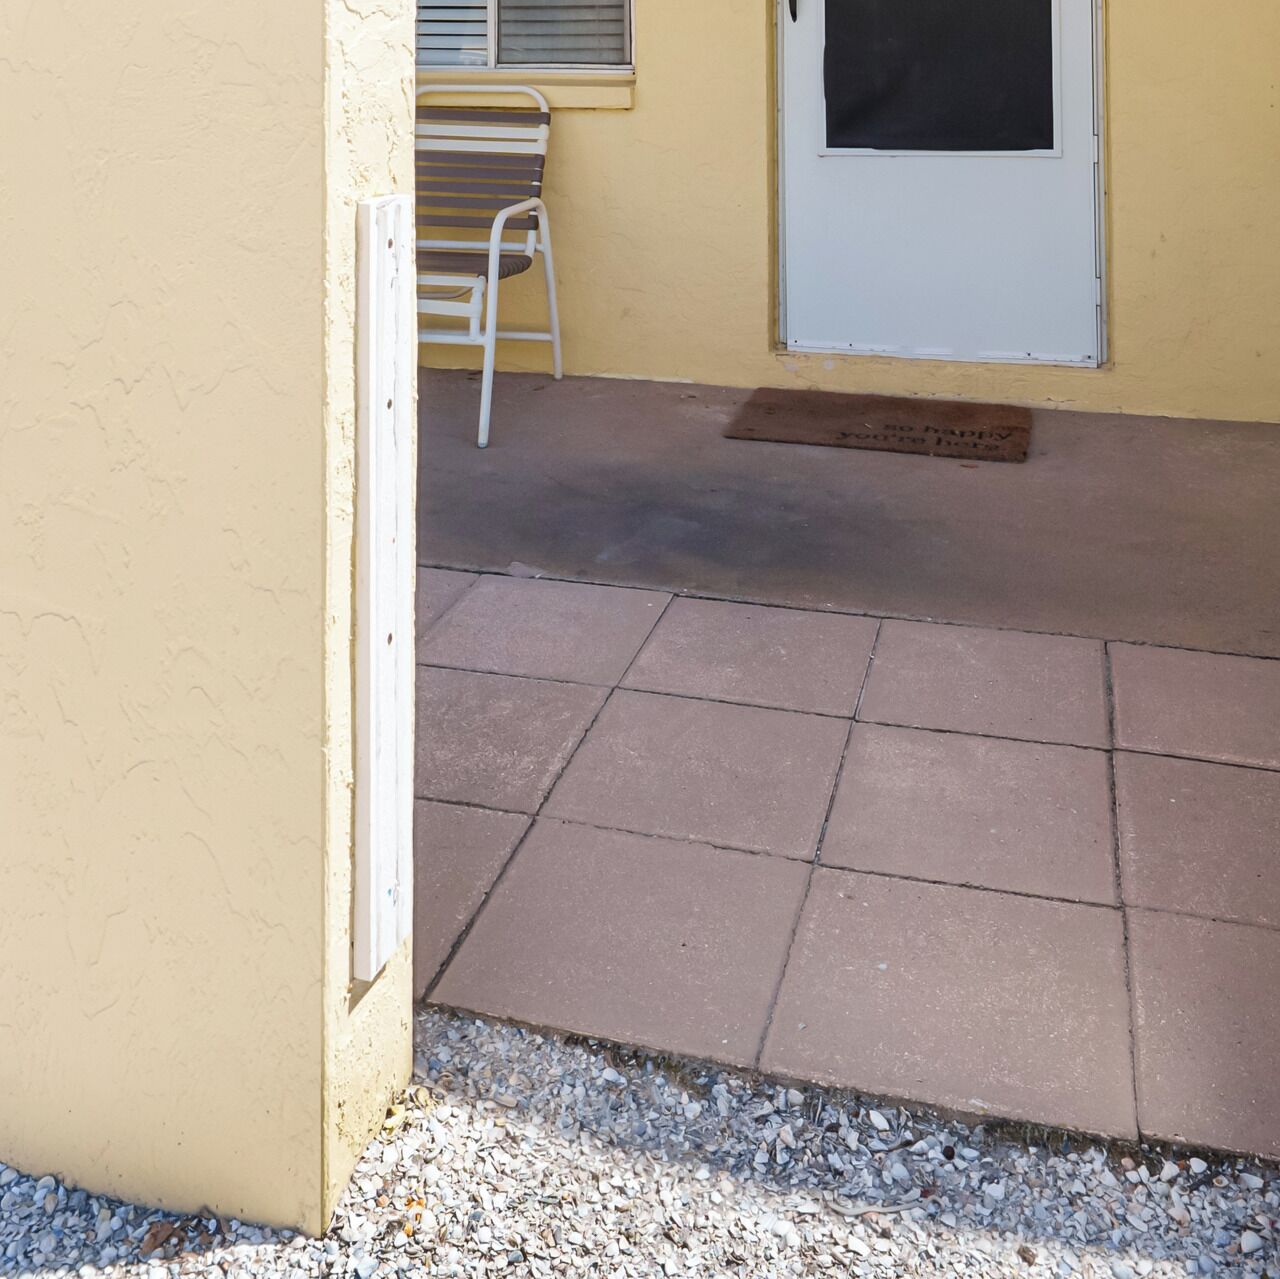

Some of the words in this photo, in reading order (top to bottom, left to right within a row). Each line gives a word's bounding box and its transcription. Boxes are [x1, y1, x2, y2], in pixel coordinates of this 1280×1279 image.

[835, 431, 926, 445] you're
[935, 436, 1000, 451] here
[883, 424, 913, 433] so
[924, 425, 1012, 442] happy
